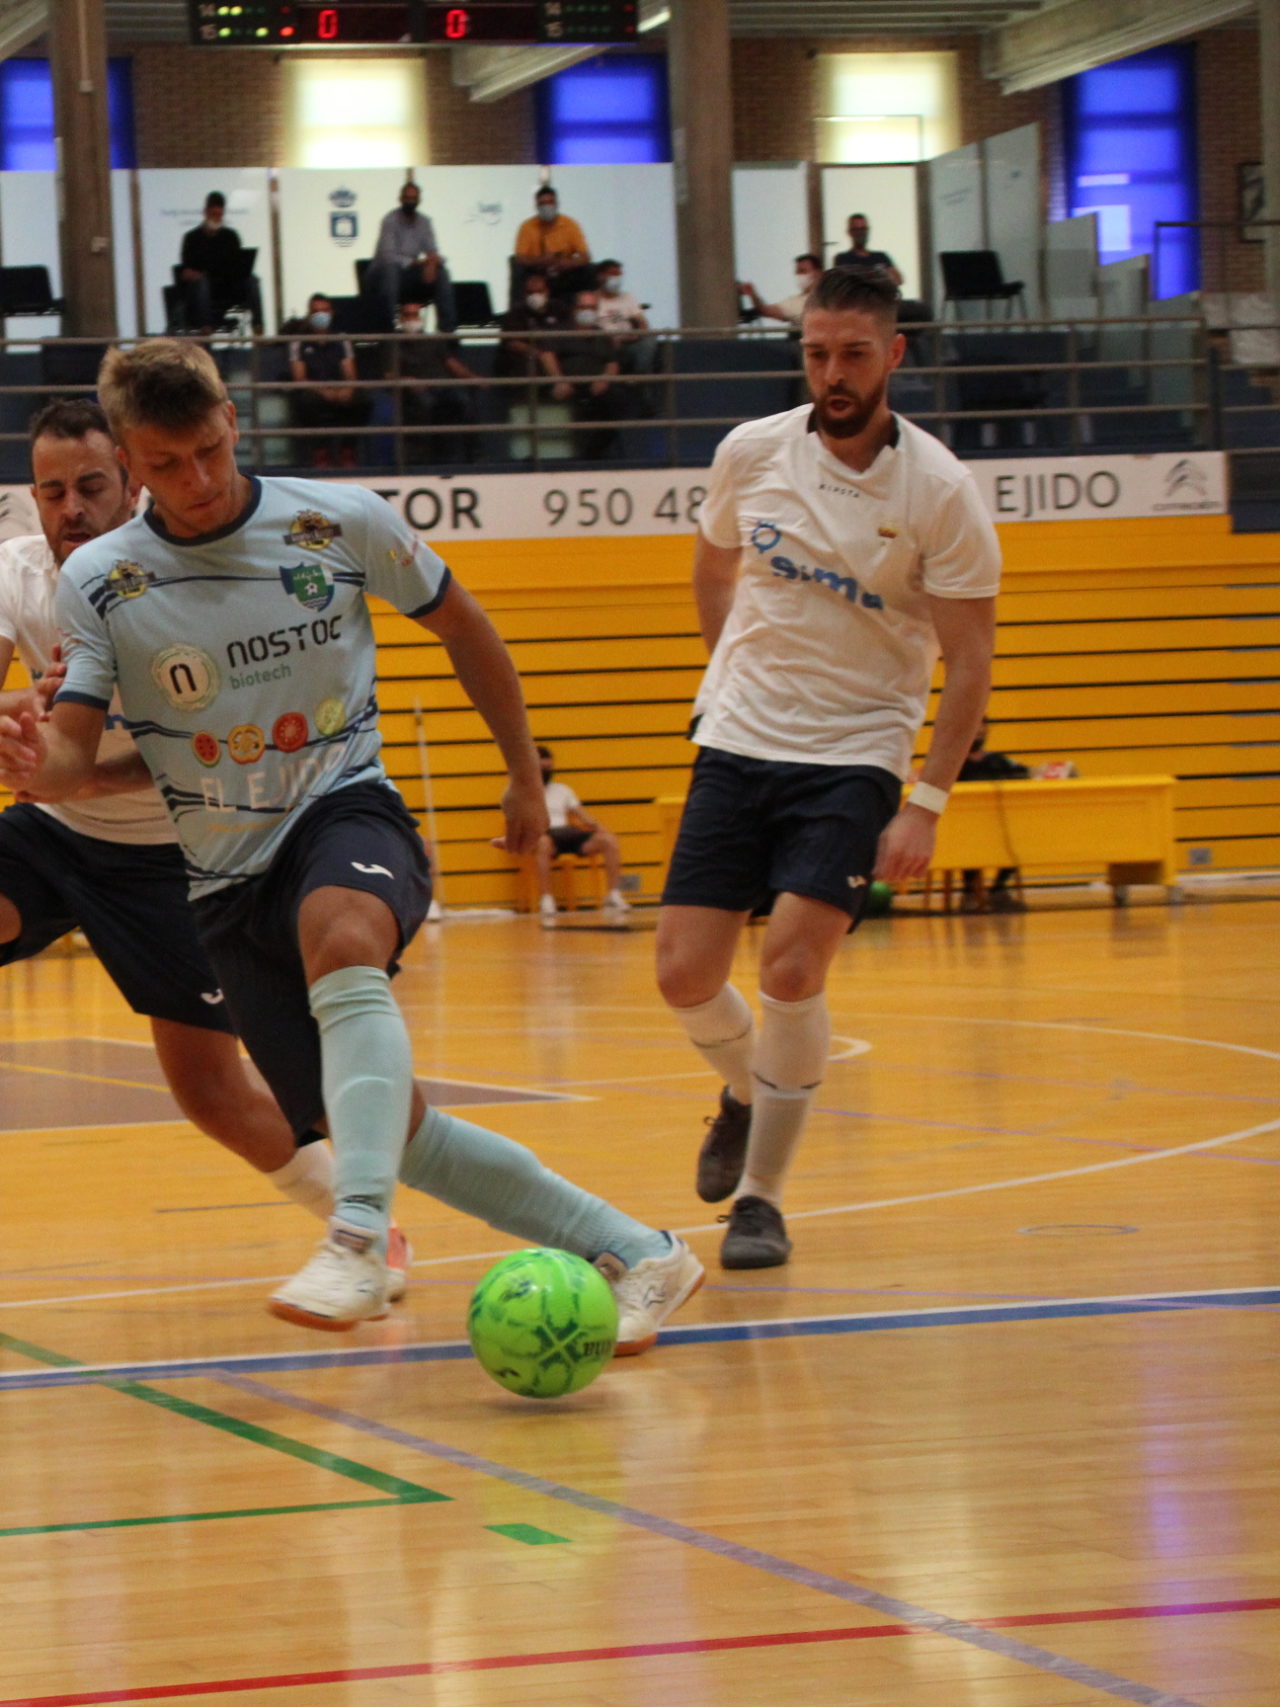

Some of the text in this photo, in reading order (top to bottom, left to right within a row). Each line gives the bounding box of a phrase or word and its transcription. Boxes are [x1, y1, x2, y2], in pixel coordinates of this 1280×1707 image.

[318, 9, 338, 39] 0
[446, 9, 467, 38] 0
[543, 488, 634, 527] 950
[995, 470, 1121, 518] EJIDO
[230, 662, 292, 690] biotech
[200, 777, 237, 812] EL
